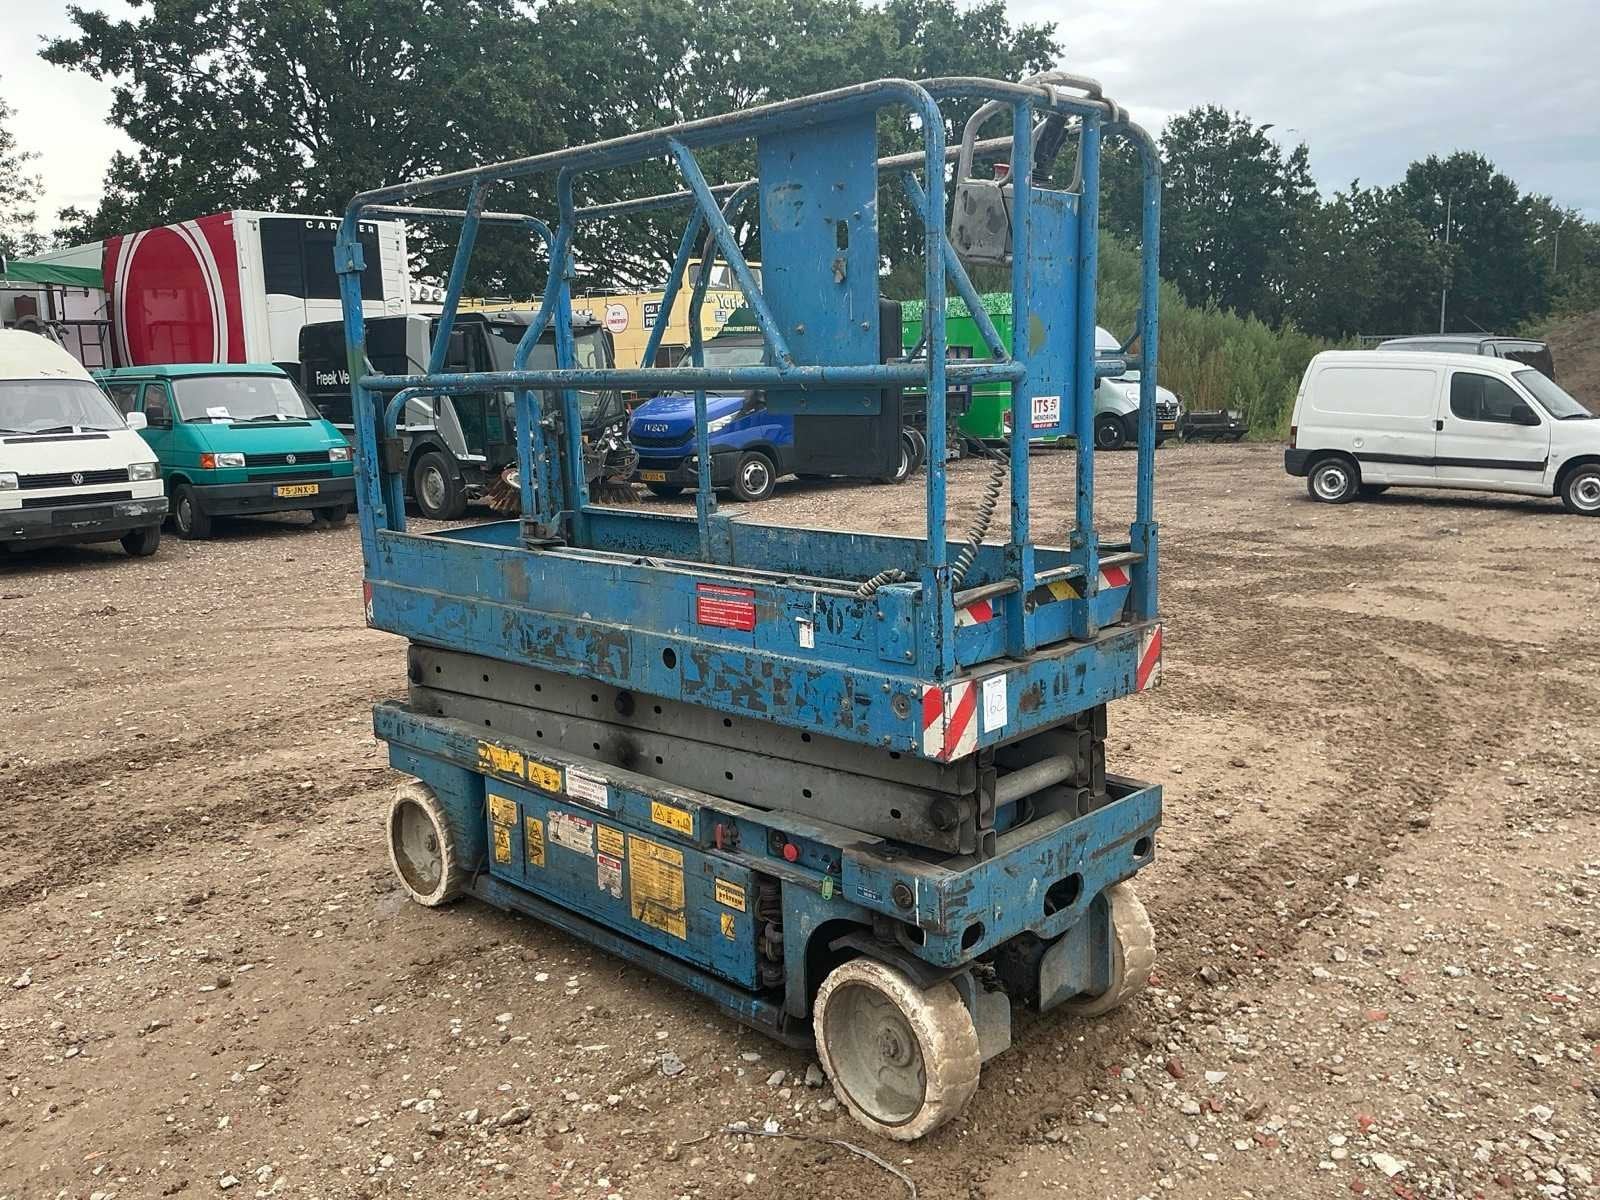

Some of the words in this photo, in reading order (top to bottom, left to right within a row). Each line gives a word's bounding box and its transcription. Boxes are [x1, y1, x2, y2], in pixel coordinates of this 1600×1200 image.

[305, 220, 374, 233] CARER
[316, 370, 337, 385] Freek
[338, 369, 350, 385] Ve
[1034, 399, 1049, 414] ITS
[644, 423, 669, 433] IVECO
[986, 692, 1005, 719] 162
